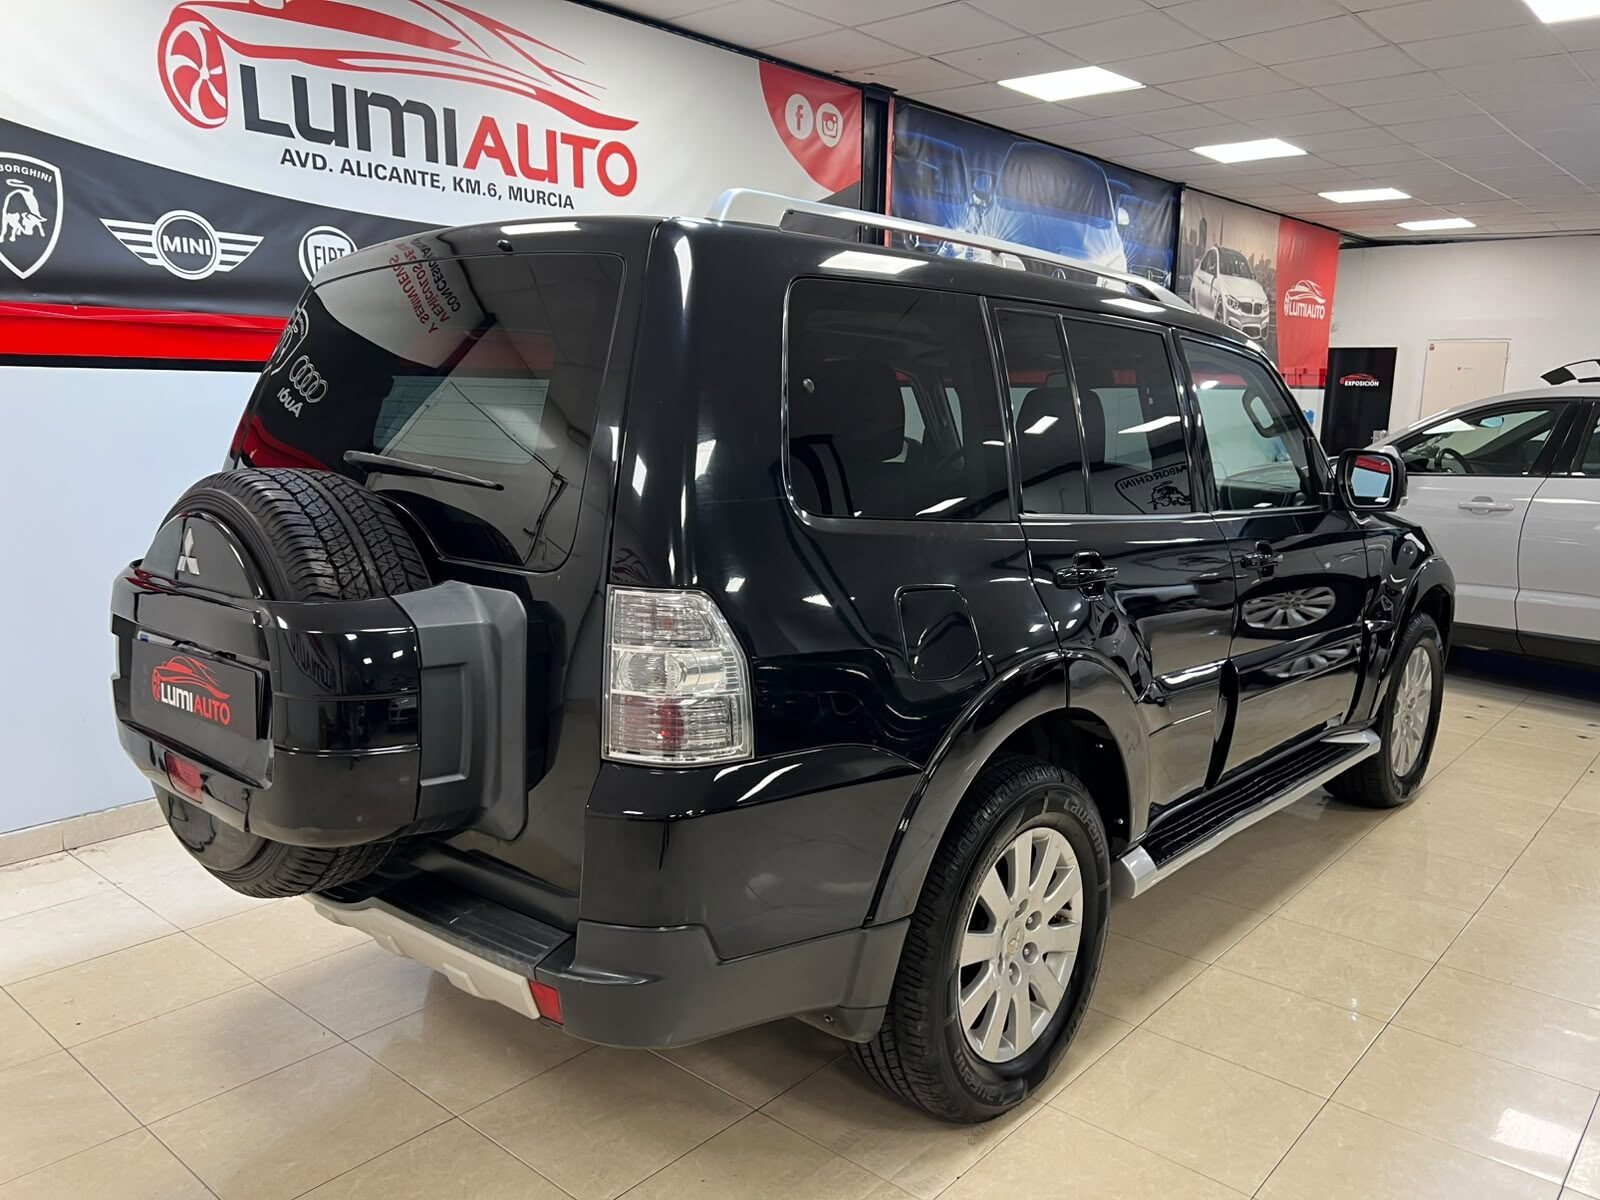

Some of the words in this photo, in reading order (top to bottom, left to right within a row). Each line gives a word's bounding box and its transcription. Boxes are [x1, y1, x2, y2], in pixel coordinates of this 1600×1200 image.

[280, 148, 334, 174] AVD.
[339, 159, 447, 193] ALICANTE,
[452, 176, 502, 201] KM.6,
[508, 186, 574, 210] MURCIA
[162, 235, 212, 256] MINI
